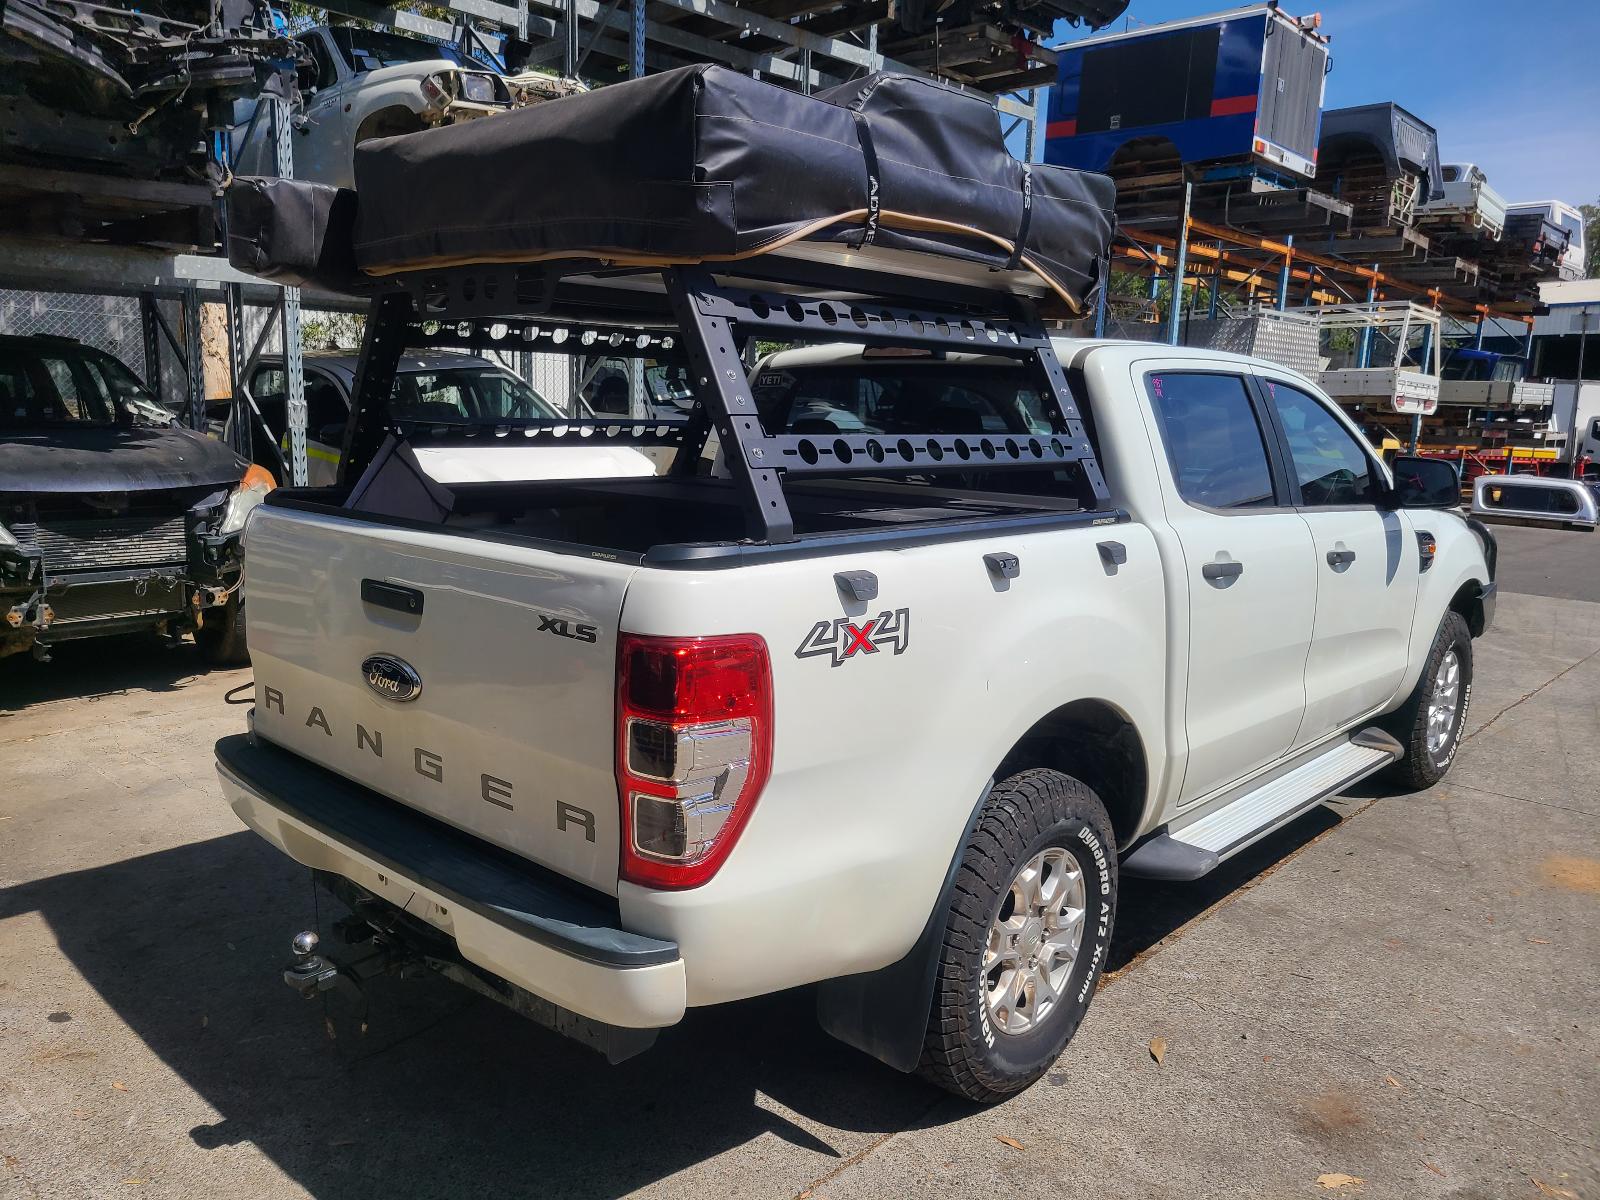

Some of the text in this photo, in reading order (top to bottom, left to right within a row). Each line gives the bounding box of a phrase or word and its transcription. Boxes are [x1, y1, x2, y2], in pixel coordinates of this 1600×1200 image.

[761, 375, 782, 385] YETI
[536, 614, 598, 644] XLS
[369, 662, 400, 693] Ford
[264, 685, 596, 843] RANGER
[1097, 902, 1110, 937] AT2
[1077, 943, 1104, 1004] Xtreme
